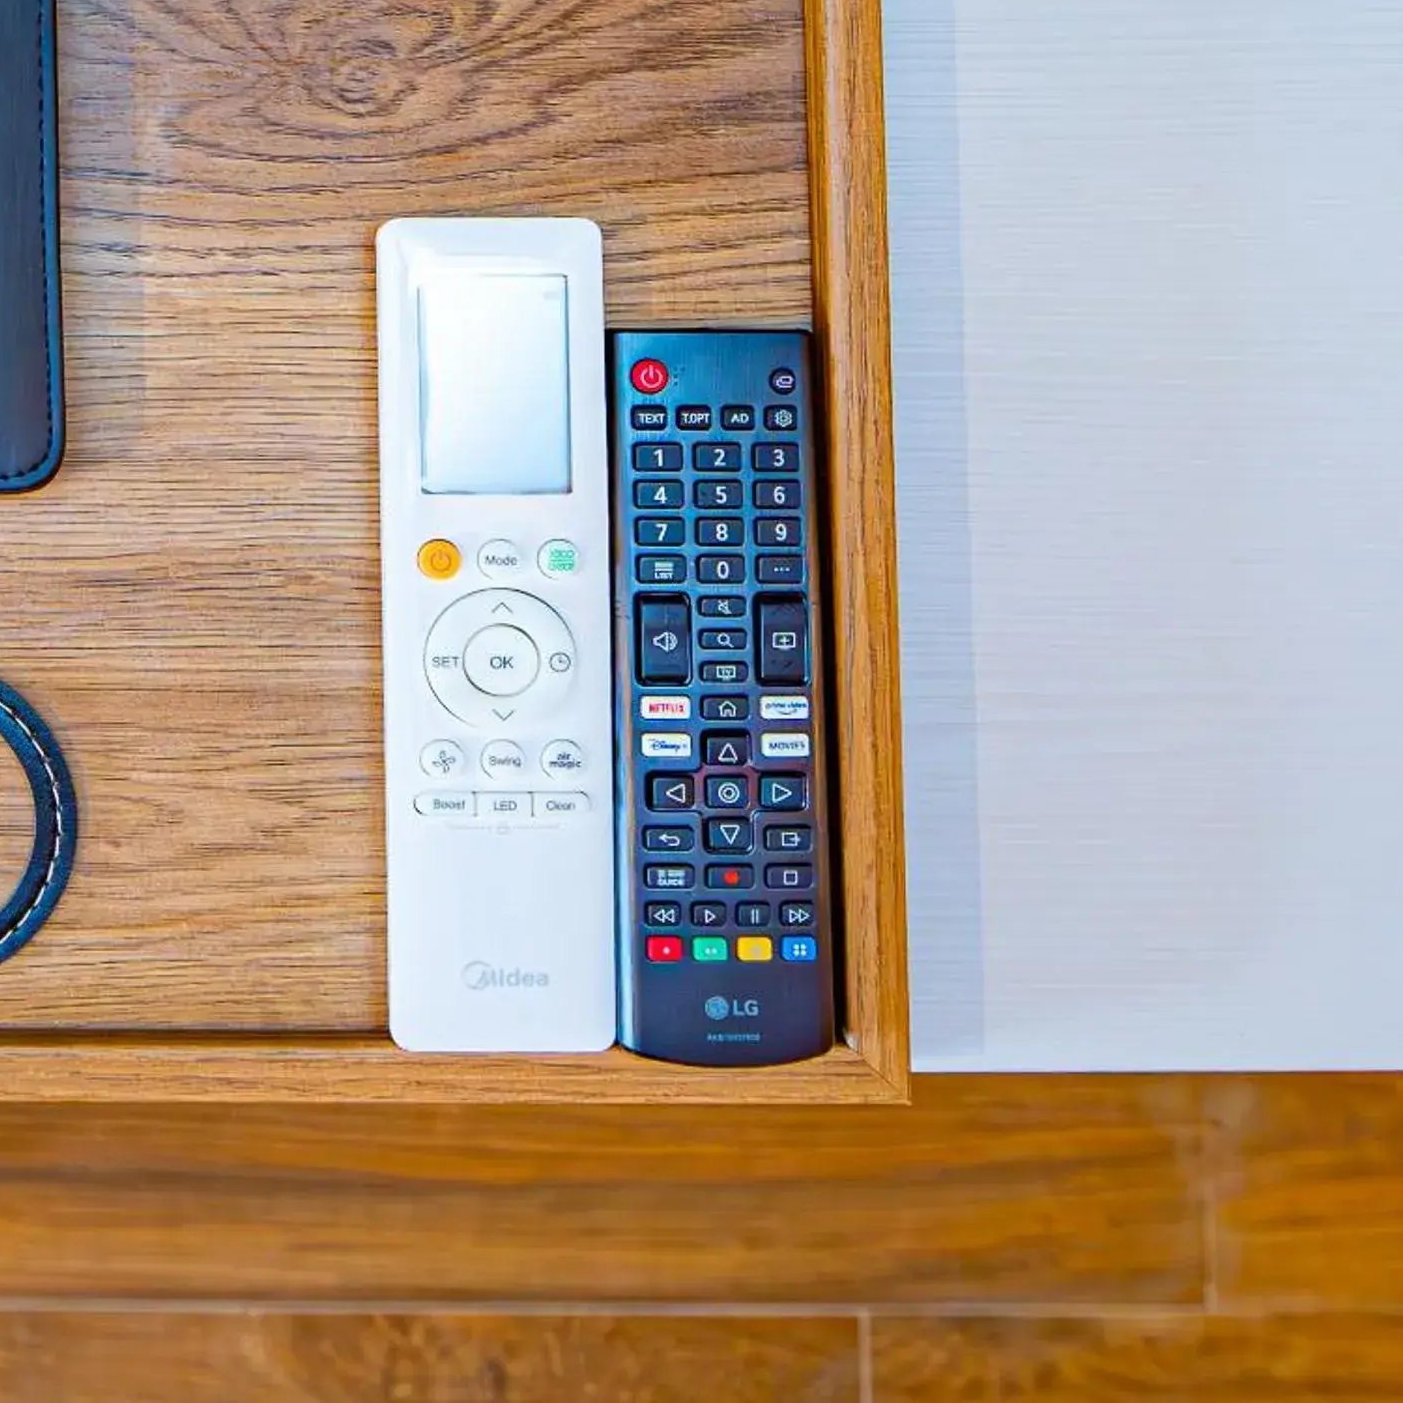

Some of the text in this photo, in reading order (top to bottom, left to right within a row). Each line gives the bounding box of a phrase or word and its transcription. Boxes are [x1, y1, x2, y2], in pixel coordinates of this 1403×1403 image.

[639, 412, 665, 424] TEXT
[731, 413, 749, 423] AD
[654, 449, 664, 467] 1
[714, 449, 726, 467] 2
[773, 449, 785, 467] 3
[654, 487, 668, 505] 4
[716, 486, 727, 504] 5
[773, 486, 786, 504] 6
[656, 523, 668, 541] 7
[716, 523, 729, 541] 8
[775, 523, 787, 541] 9
[485, 555, 517, 566] Mode
[716, 561, 729, 579] 0
[432, 657, 459, 668] SET
[490, 656, 514, 669] OK
[488, 756, 521, 768] Swing
[433, 799, 466, 810] Boost
[493, 801, 517, 811] LED
[546, 801, 575, 811] Clean
[733, 1000, 759, 1016] LG
